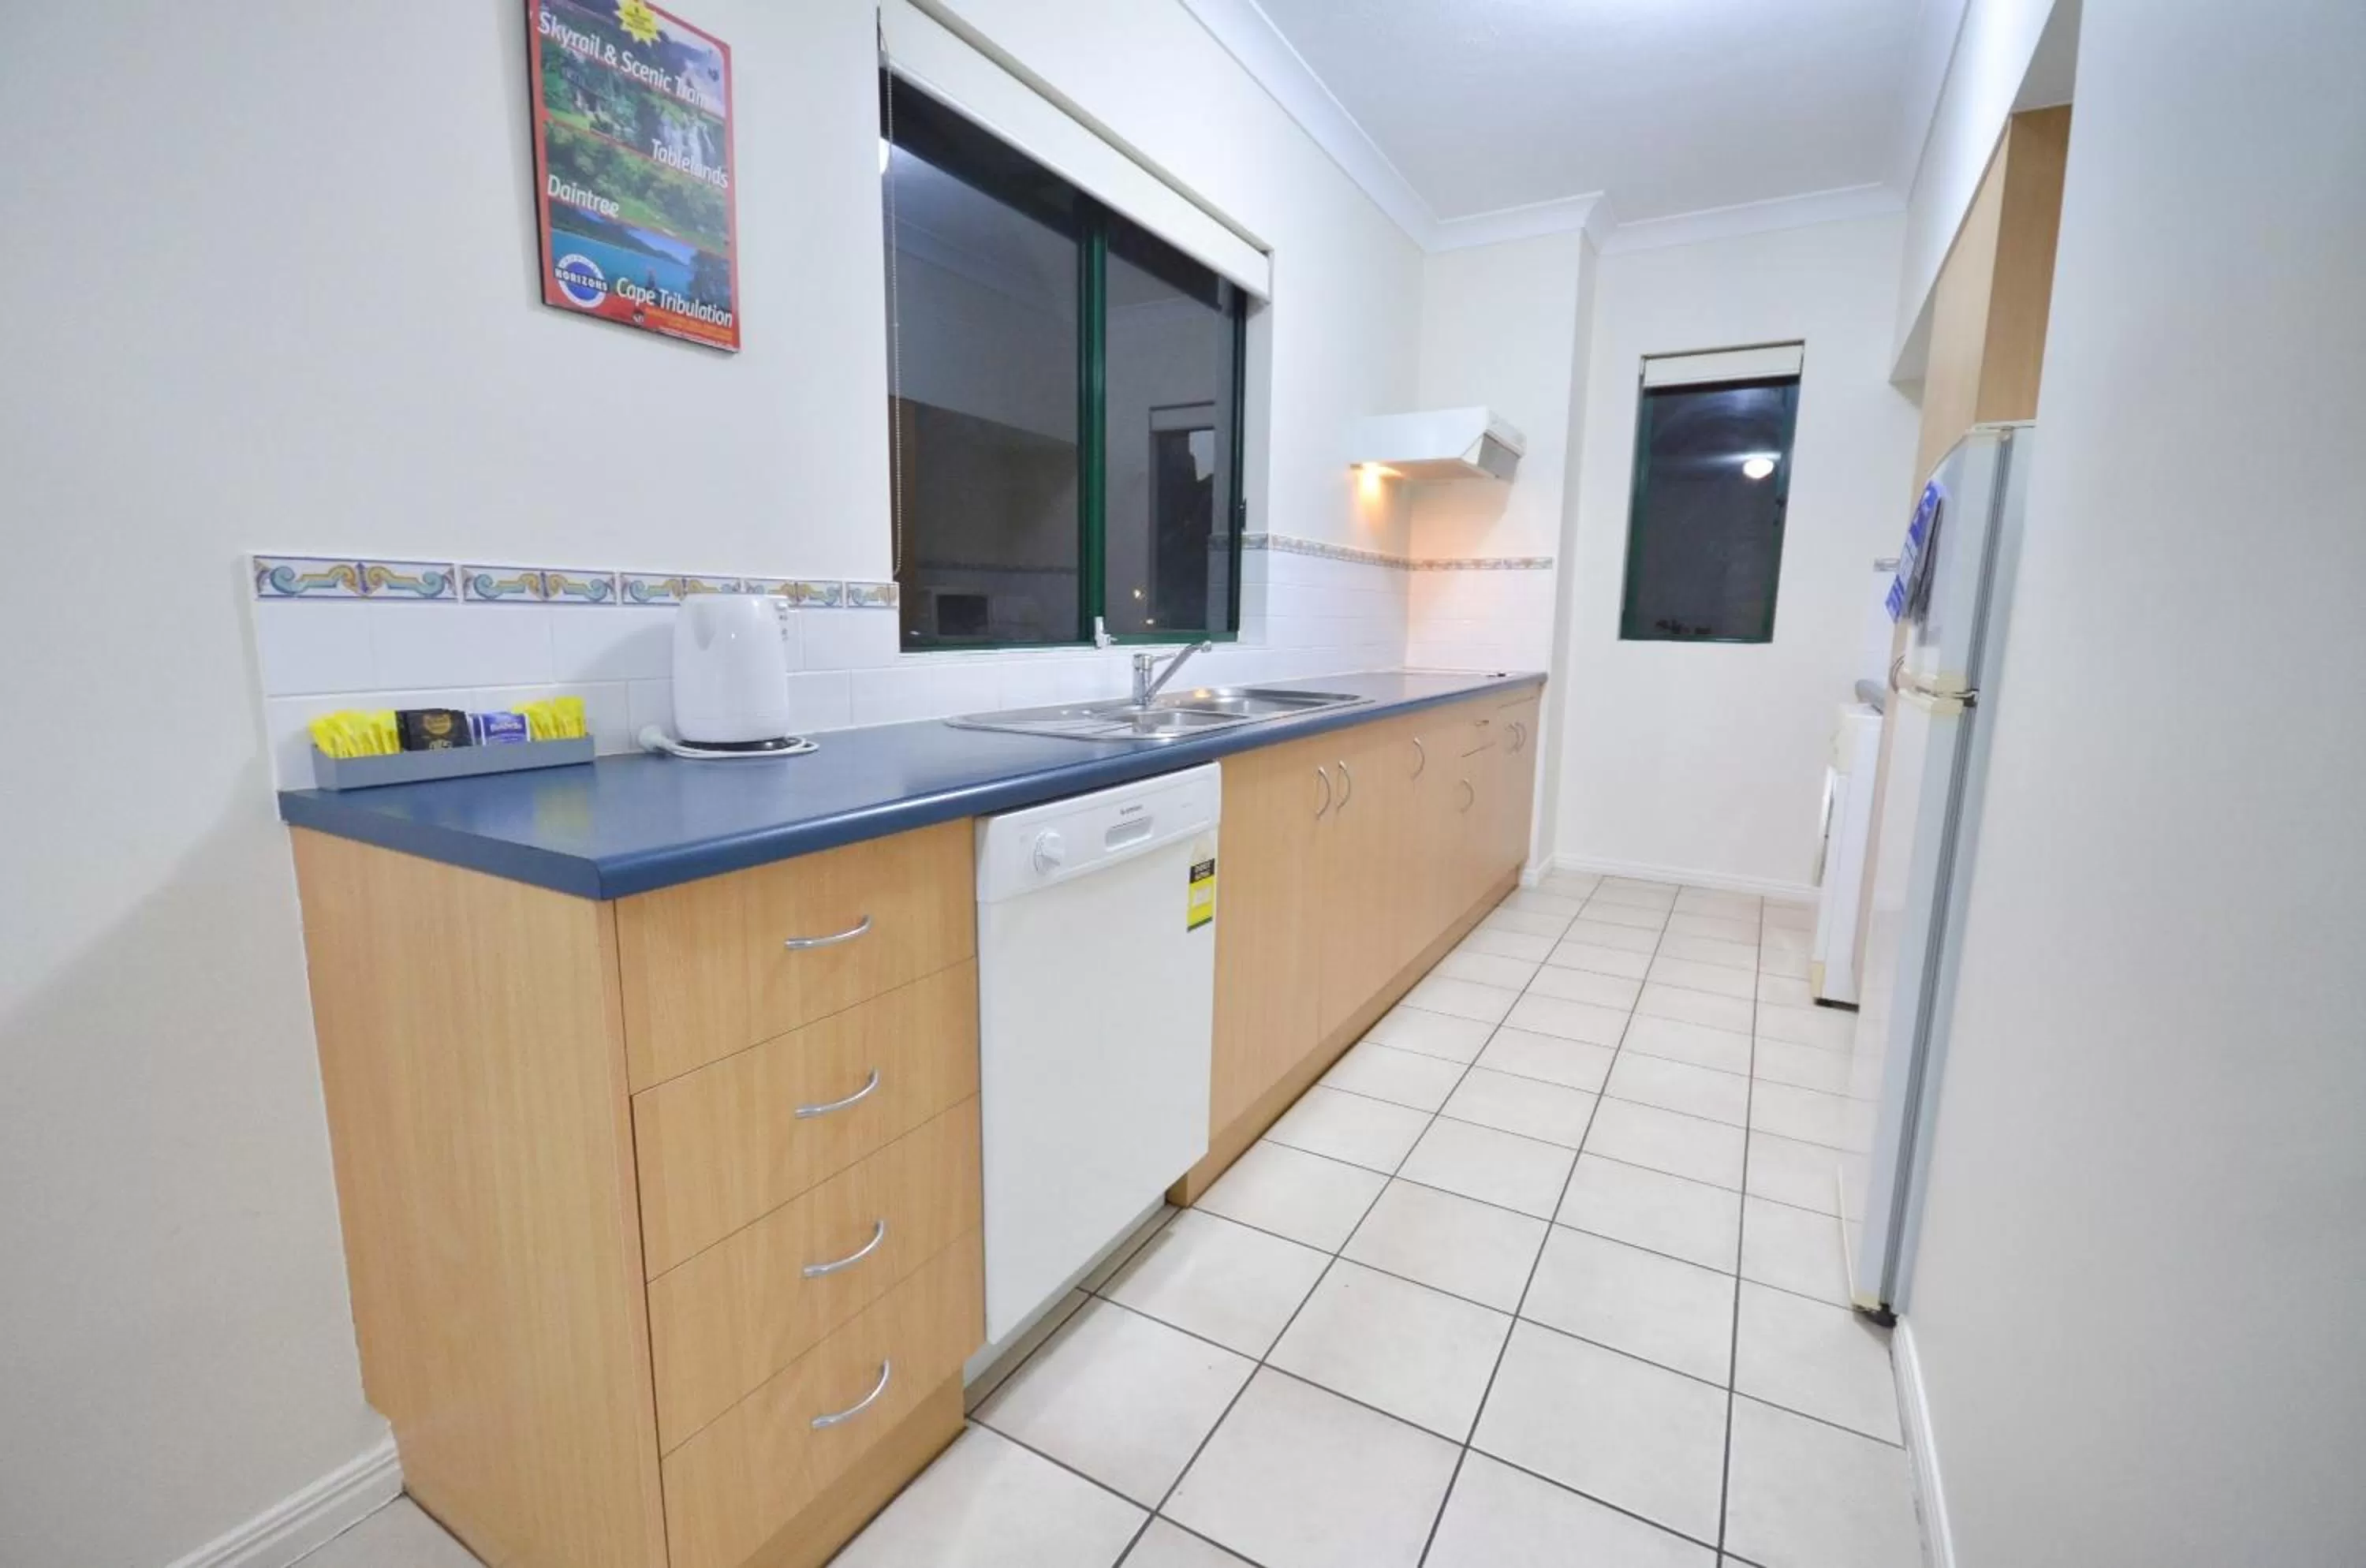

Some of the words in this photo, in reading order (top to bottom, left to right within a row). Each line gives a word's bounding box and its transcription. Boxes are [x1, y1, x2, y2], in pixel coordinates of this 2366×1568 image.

[537, 10, 599, 59] Skyrail
[604, 44, 617, 65] &
[620, 50, 672, 93] Scenic
[651, 138, 728, 189] Tablelands
[547, 174, 619, 217] Daintree
[554, 267, 608, 292] HORIZONS
[616, 277, 655, 306] Cape
[659, 289, 733, 328] Tribulation
